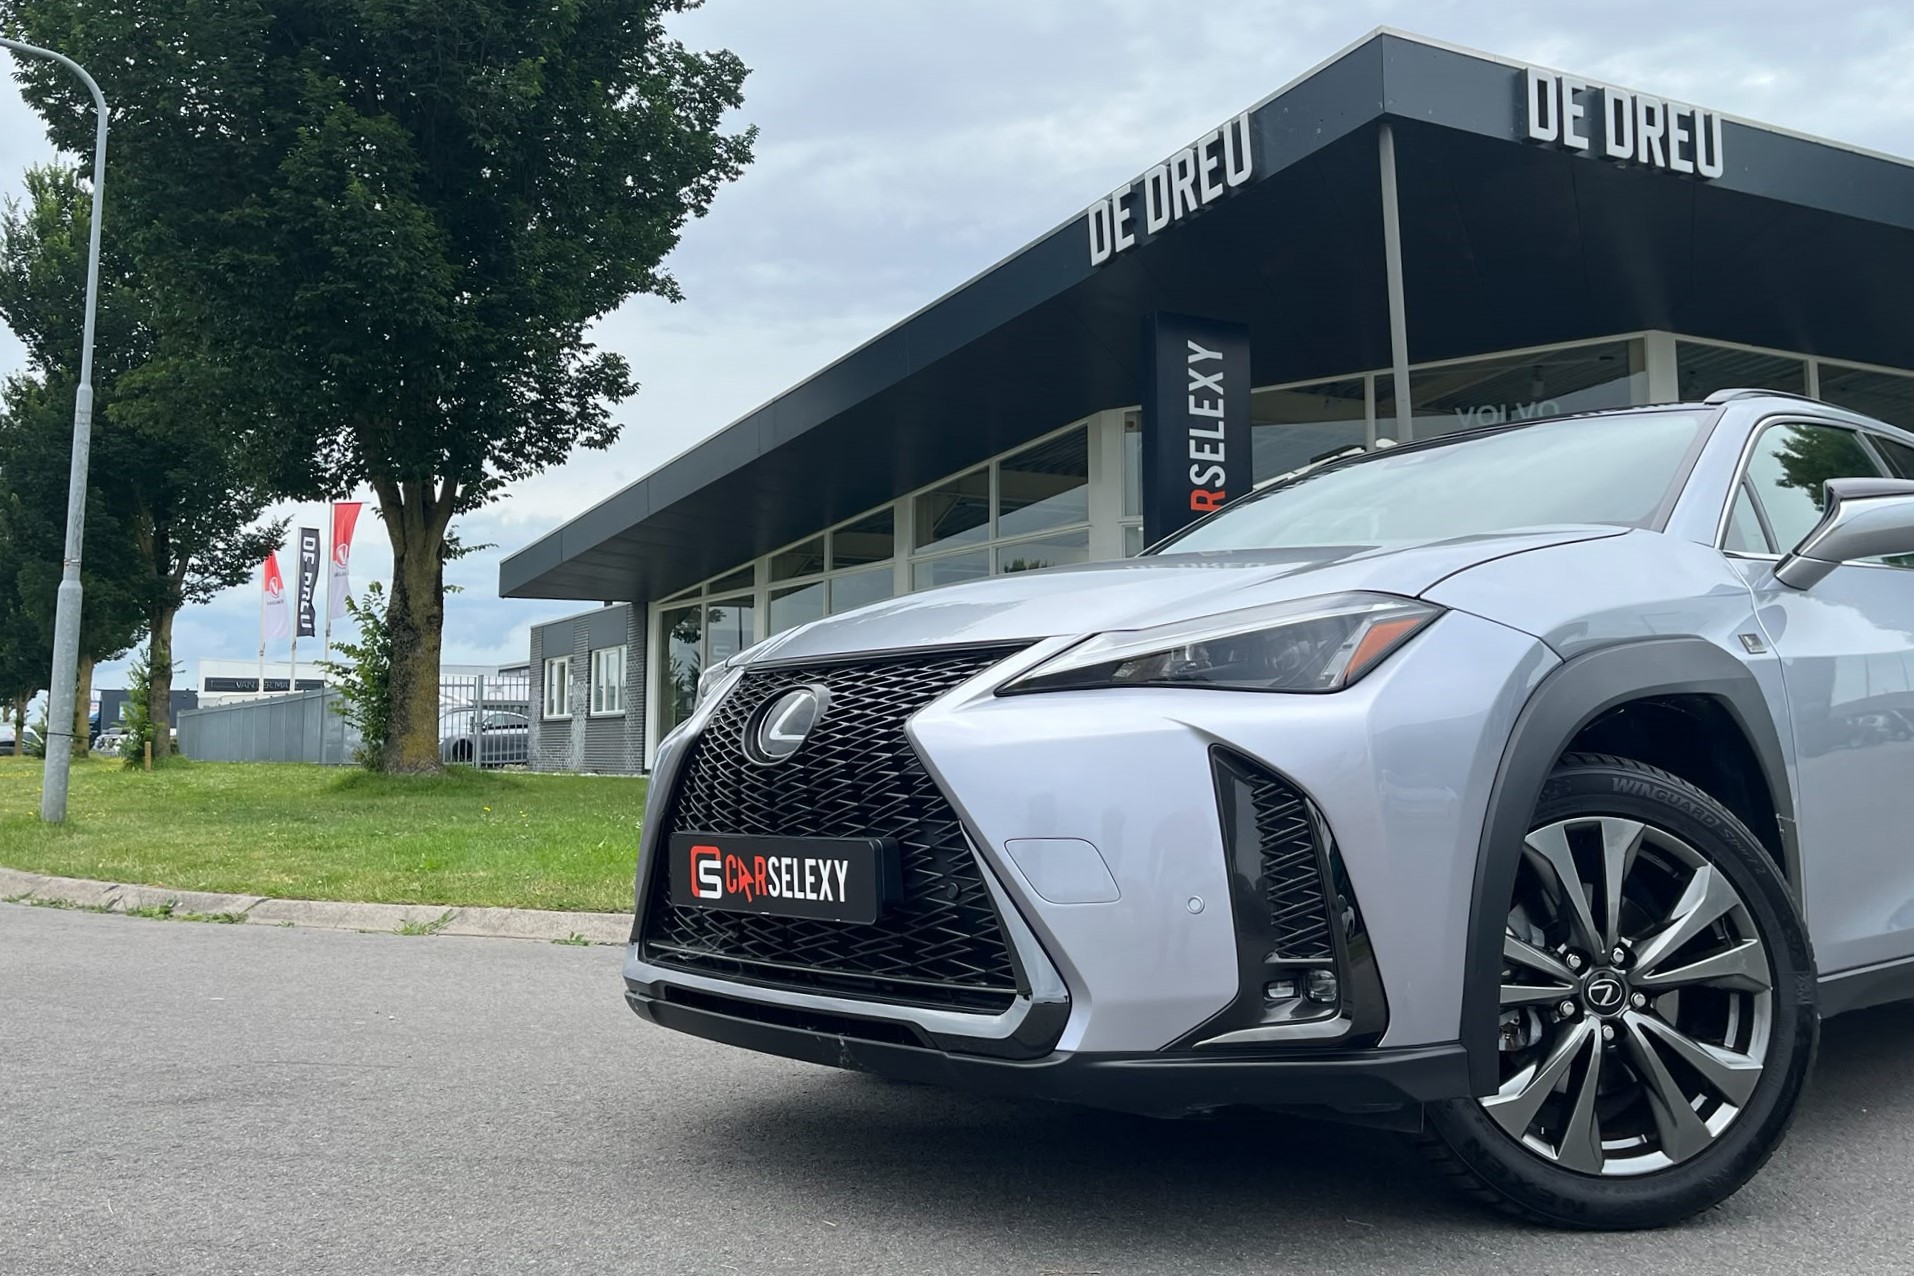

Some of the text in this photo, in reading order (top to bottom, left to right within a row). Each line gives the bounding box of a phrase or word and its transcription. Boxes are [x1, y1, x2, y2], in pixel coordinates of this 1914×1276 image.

[1527, 67, 1723, 179] DE DREU
[1088, 111, 1253, 267] DE DREU
[1612, 777, 1721, 828] WINGUARD
